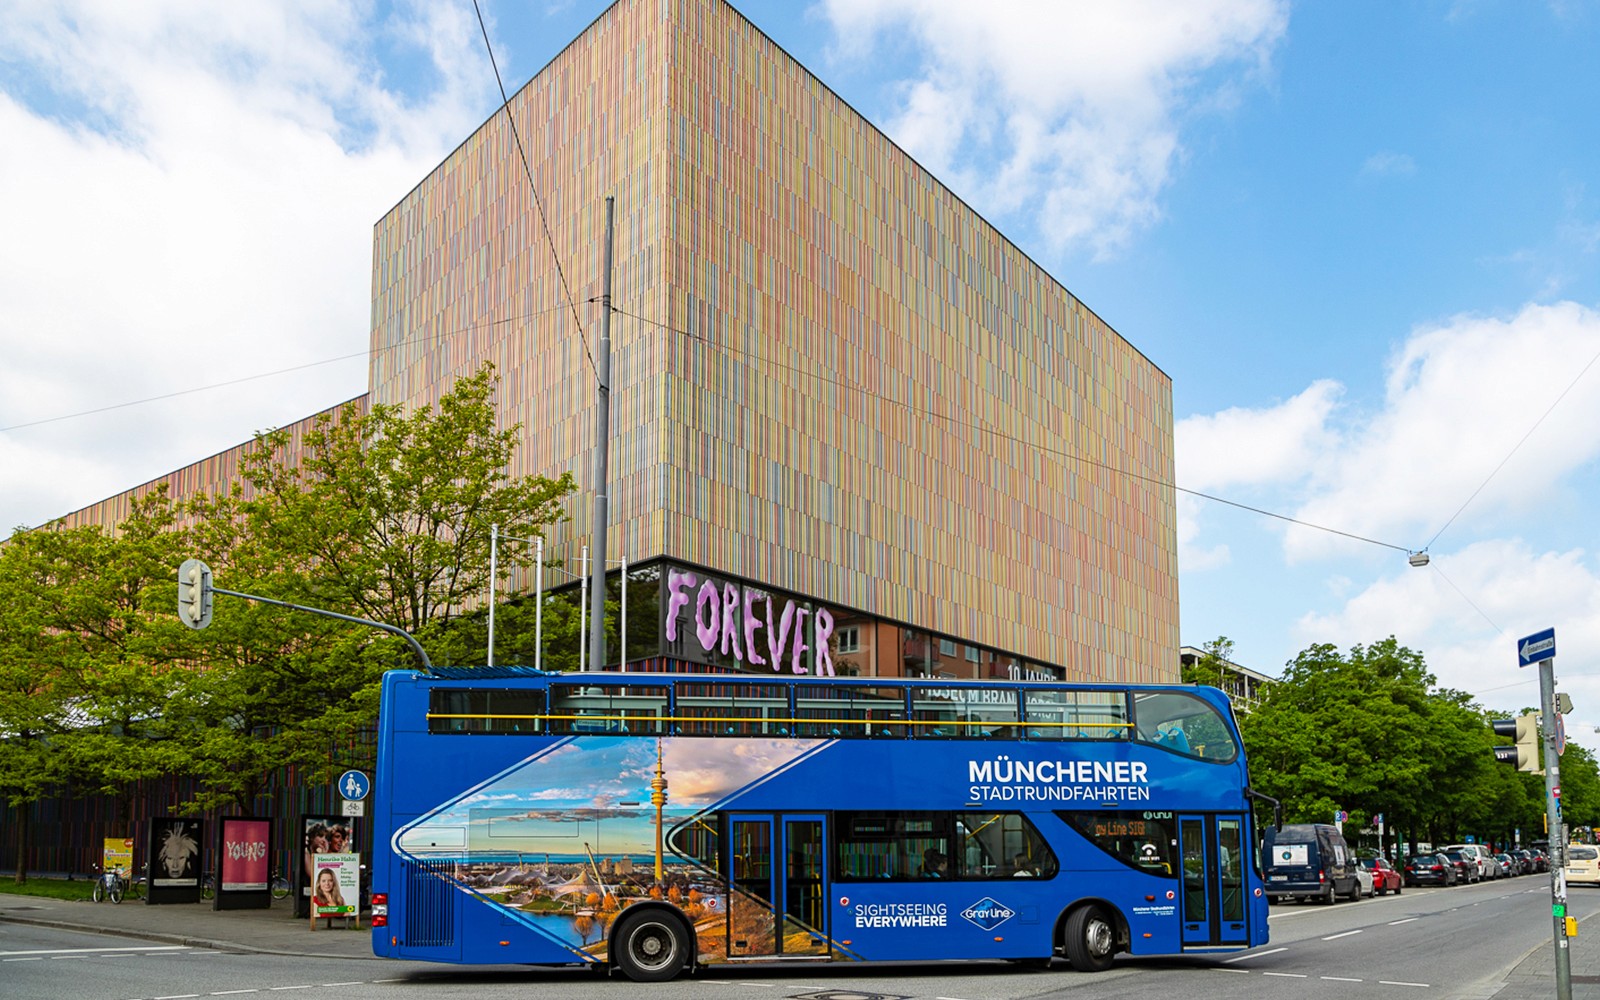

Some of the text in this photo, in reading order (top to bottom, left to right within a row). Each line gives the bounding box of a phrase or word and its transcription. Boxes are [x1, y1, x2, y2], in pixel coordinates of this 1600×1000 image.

[666, 568, 836, 677] FOREVER
[1007, 664, 1020, 681] 10
[968, 755, 1148, 783] MÜNCHENER
[969, 785, 1149, 801] STADTRUNDFAHRTEN
[226, 840, 266, 862] YOUNG
[855, 903, 947, 917] SIGHTSEEING
[855, 915, 947, 929] EVERYWHERE
